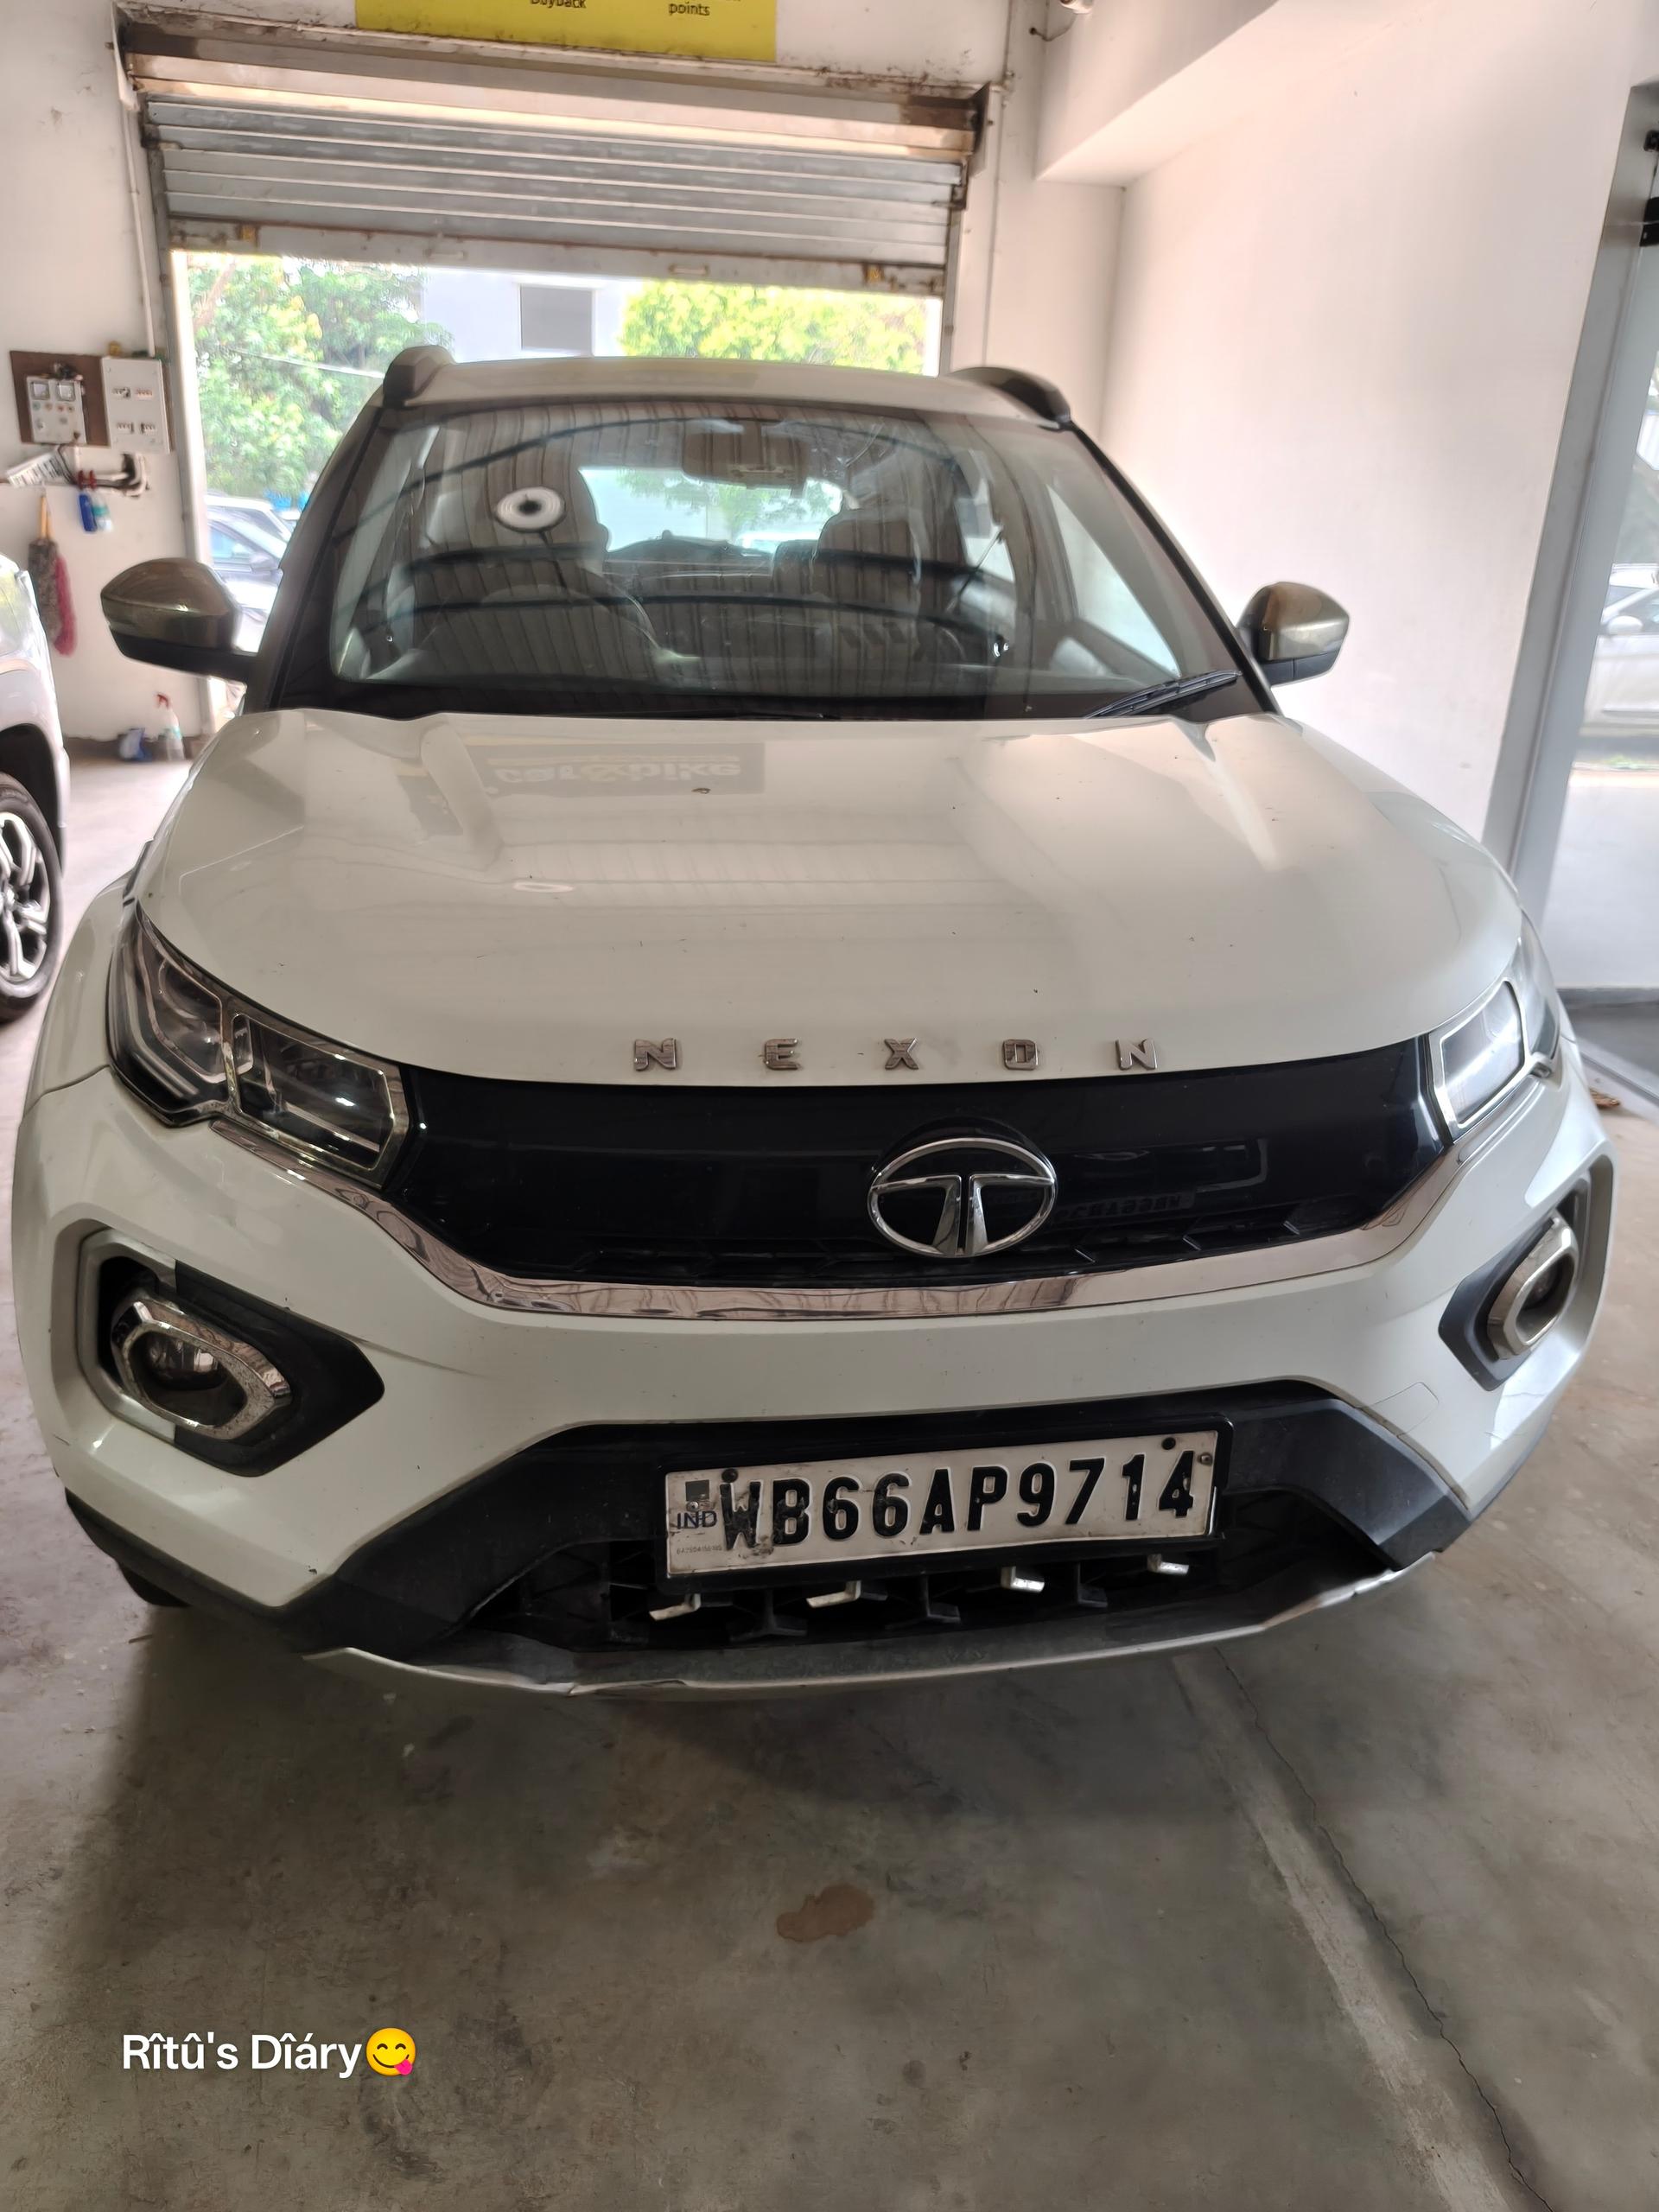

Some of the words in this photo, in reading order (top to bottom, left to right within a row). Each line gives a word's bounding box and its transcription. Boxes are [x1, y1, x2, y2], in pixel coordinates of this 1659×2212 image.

[668, 1, 710, 16] points
[632, 1037, 1159, 1071] NEXON
[719, 1450, 1195, 1551] WB66AP9714
[677, 1510, 718, 1530] IND
